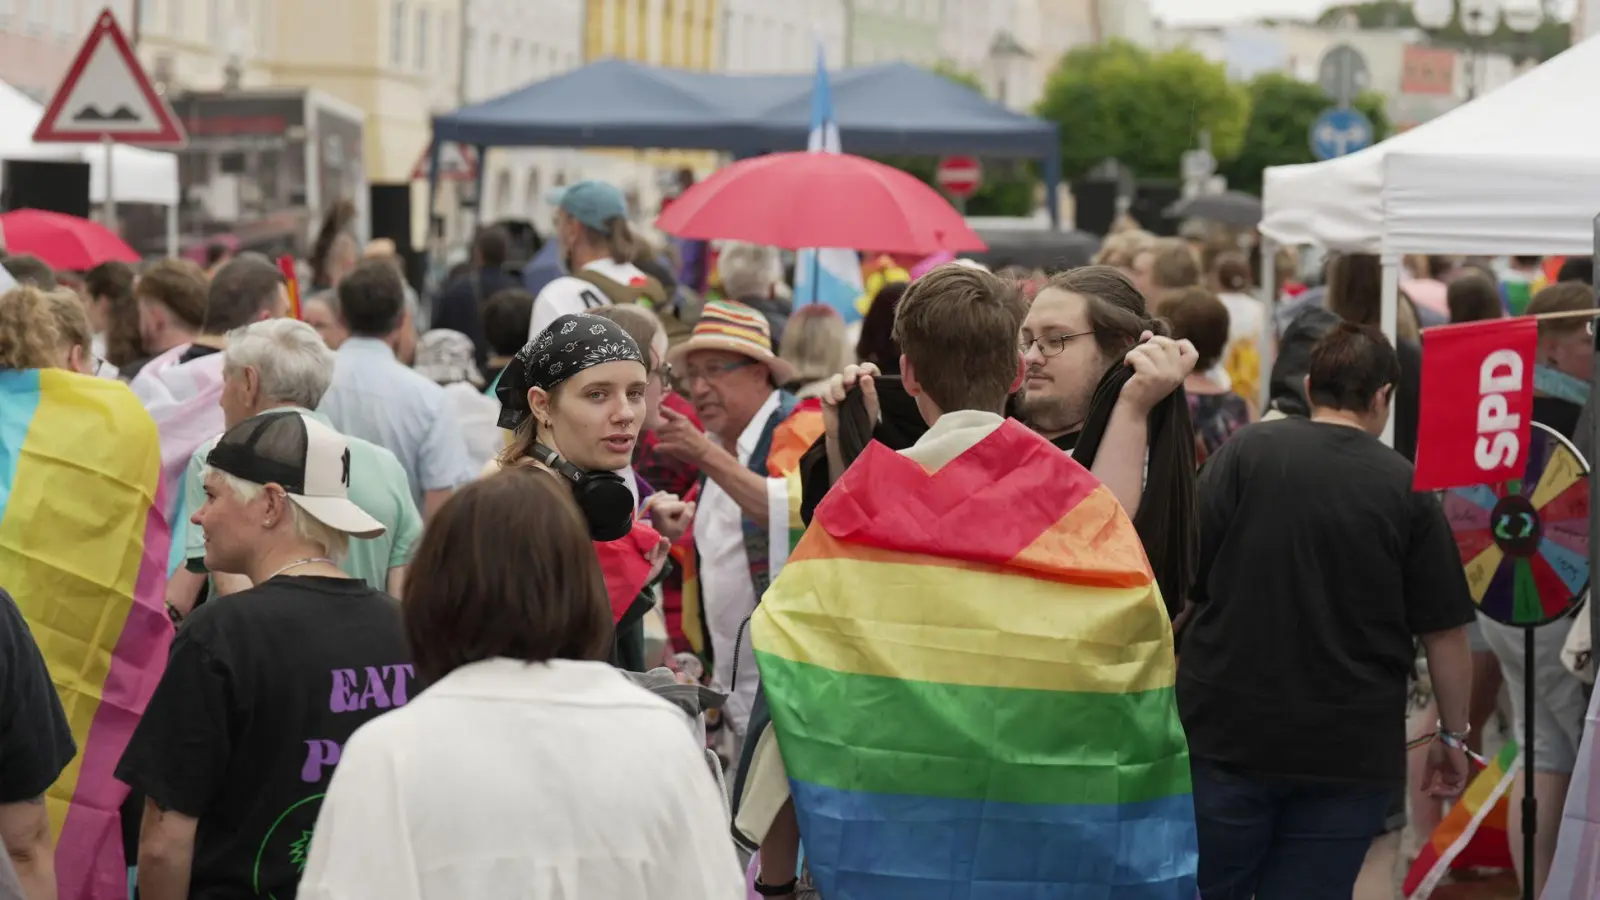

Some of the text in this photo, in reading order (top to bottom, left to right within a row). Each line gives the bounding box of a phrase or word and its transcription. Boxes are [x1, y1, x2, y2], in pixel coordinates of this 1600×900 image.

[1474, 349, 1523, 470] SPD
[330, 664, 415, 713] EAT
[301, 739, 343, 783] P
